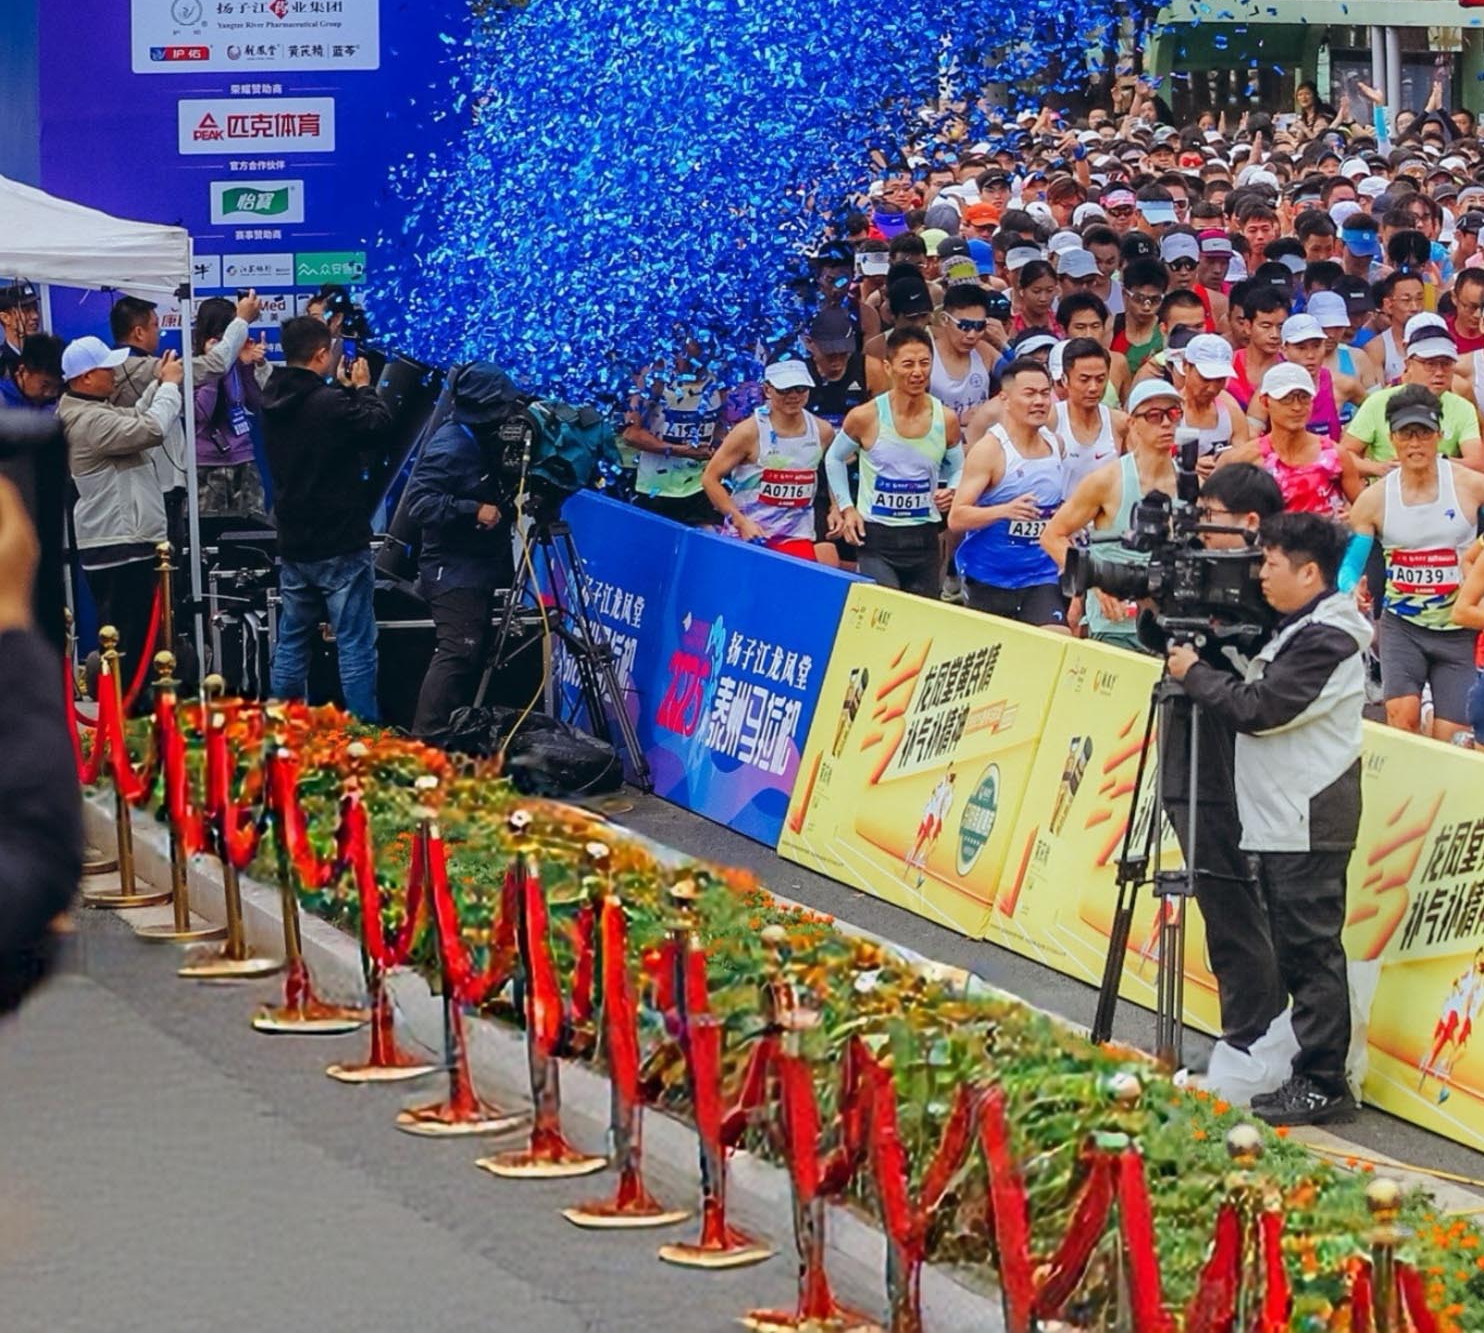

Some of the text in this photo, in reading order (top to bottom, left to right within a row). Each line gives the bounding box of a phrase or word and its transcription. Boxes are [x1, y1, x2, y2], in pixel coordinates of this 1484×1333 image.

[319, 20, 342, 30] Group
[227, 113, 320, 138] 匹克体育
[193, 130, 224, 141] PEAK
[762, 483, 804, 497] A0716
[875, 493, 921, 509] A1061
[1396, 568, 1445, 584] A0739
[726, 631, 812, 691] 扬子江龙凤堂
[705, 676, 803, 776] 泰州马拉松
